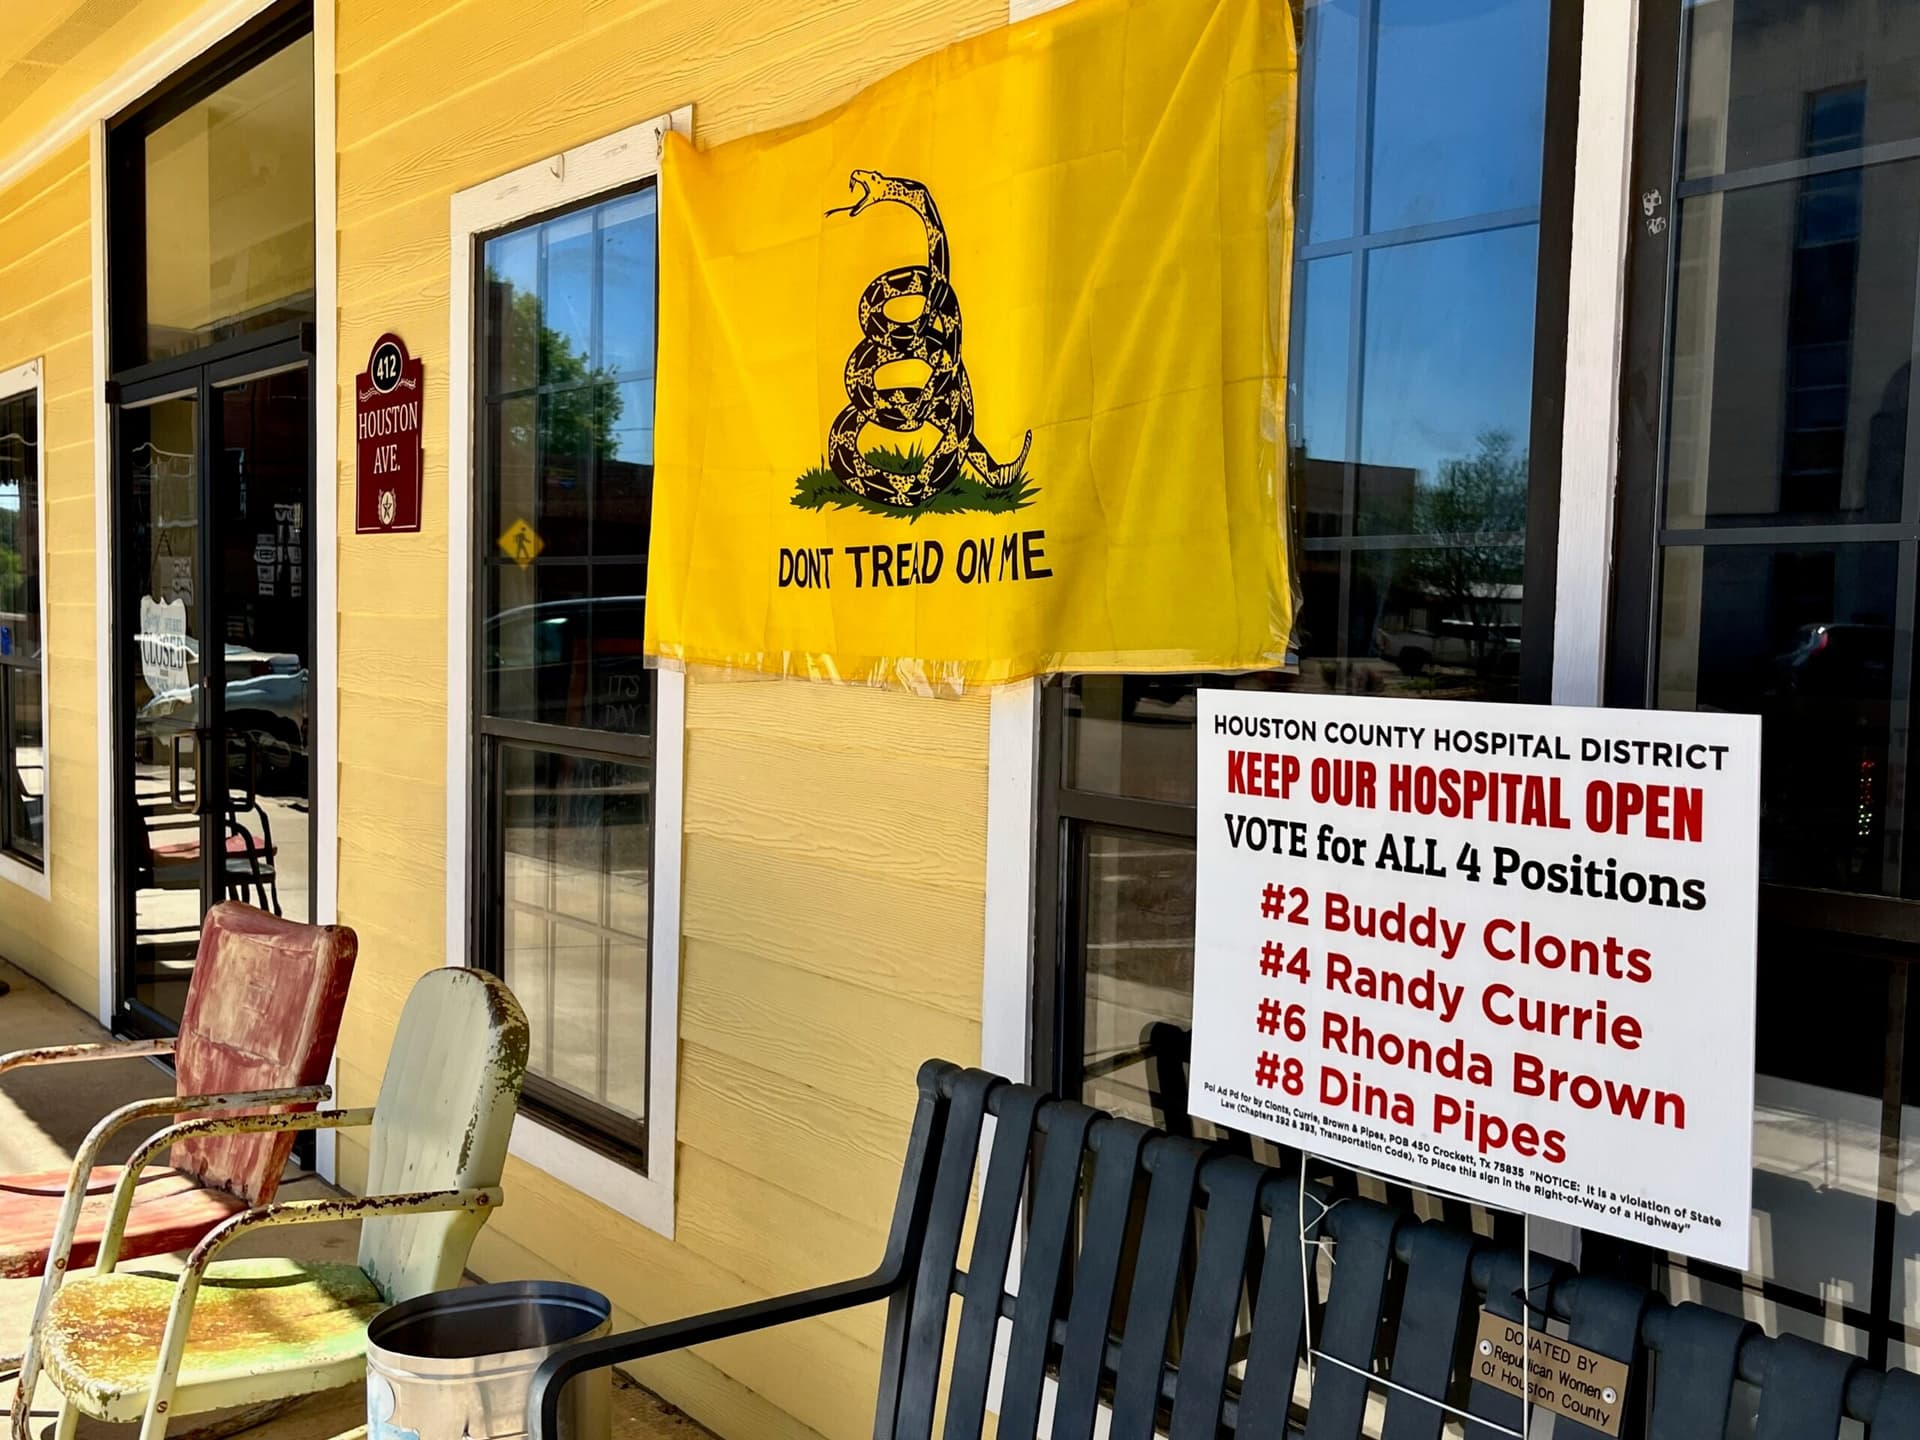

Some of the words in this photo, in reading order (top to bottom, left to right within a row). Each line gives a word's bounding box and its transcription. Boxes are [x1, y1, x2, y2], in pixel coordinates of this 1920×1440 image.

[377, 354, 397, 380] 412
[358, 401, 418, 441] HOUSTON
[373, 444, 401, 475] AVE.
[778, 548, 833, 589] DONT
[845, 540, 944, 588] TREAD
[956, 537, 995, 584] ON
[998, 530, 1053, 582] ME
[142, 631, 184, 669] CLOSED
[1214, 714, 1317, 742] HOUSTON
[1324, 721, 1426, 750] COUNTY
[1434, 728, 1571, 761] HOSPITAL
[1581, 737, 1730, 771] DISTRICT
[1227, 749, 1301, 800] KEEP
[1310, 757, 1377, 809] OUR
[1389, 763, 1571, 830] HOSPITAL
[1585, 779, 1703, 843] OPEN
[1224, 813, 1308, 859] VOTE
[1316, 823, 1367, 867] for
[1374, 833, 1447, 878] ALL
[1456, 841, 1481, 883] 4
[1492, 846, 1707, 911] Positions
[1260, 882, 1309, 926] #2
[1324, 891, 1466, 960] Buddy
[1483, 918, 1652, 984] Clonts
[1259, 940, 1311, 985] #4
[1326, 951, 1465, 1024] Randy
[1481, 983, 1643, 1050] Currie
[1256, 997, 1307, 1043] #6
[1322, 1010, 1493, 1088] Rhonda
[1513, 1052, 1685, 1130] Brown
[1254, 1050, 1304, 1097] #8
[1319, 1065, 1415, 1127] Dina
[1433, 1093, 1566, 1164] Pipes
[1203, 1080, 1216, 1092] Pol
[1216, 1085, 1228, 1096] Ad
[1228, 1088, 1240, 1100] Pd
[1239, 1091, 1252, 1103] for
[1252, 1095, 1263, 1108] by
[1263, 1098, 1291, 1117] Clonts,
[1292, 1106, 1320, 1125] Currie,
[1321, 1114, 1350, 1131] Brown
[1350, 1123, 1358, 1133] &
[1359, 1125, 1387, 1143] Pipes,
[1388, 1132, 1409, 1147] POB
[1410, 1139, 1430, 1153] 450
[1431, 1144, 1477, 1167] Crockett,
[1478, 1156, 1491, 1169] Tx
[1493, 1159, 1524, 1178] 75835
[1585, 1183, 1595, 1196] It
[1597, 1186, 1607, 1199] is
[1608, 1191, 1617, 1201] a
[1618, 1193, 1671, 1215] violation
[1673, 1207, 1687, 1219] of
[1689, 1209, 1722, 1228] State
[1220, 1098, 1235, 1110] Law
[1236, 1102, 1274, 1122] (Chapters
[1274, 1113, 1290, 1127] 392
[1290, 1118, 1297, 1129] &
[1298, 1120, 1317, 1136] 393,
[1318, 1126, 1383, 1153] Transportation
[1383, 1144, 1415, 1163] Code),
[1416, 1152, 1429, 1165] To
[1430, 1156, 1457, 1173] Place
[1458, 1164, 1477, 1178] this
[1478, 1170, 1500, 1185] sign
[1501, 1175, 1512, 1188] in
[1513, 1179, 1531, 1193] the
[1533, 1184, 1606, 1214] Right-of-Way
[1608, 1204, 1622, 1216] of
[1623, 1208, 1631, 1219] a
[1504, 1327, 1571, 1364] DONATED
[1577, 1355, 1598, 1374] BY
[1481, 1361, 1496, 1377] Of
[1501, 1368, 1555, 1402] Houston
[1561, 1394, 1610, 1427] County
[1558, 1370, 1602, 1400] Women
